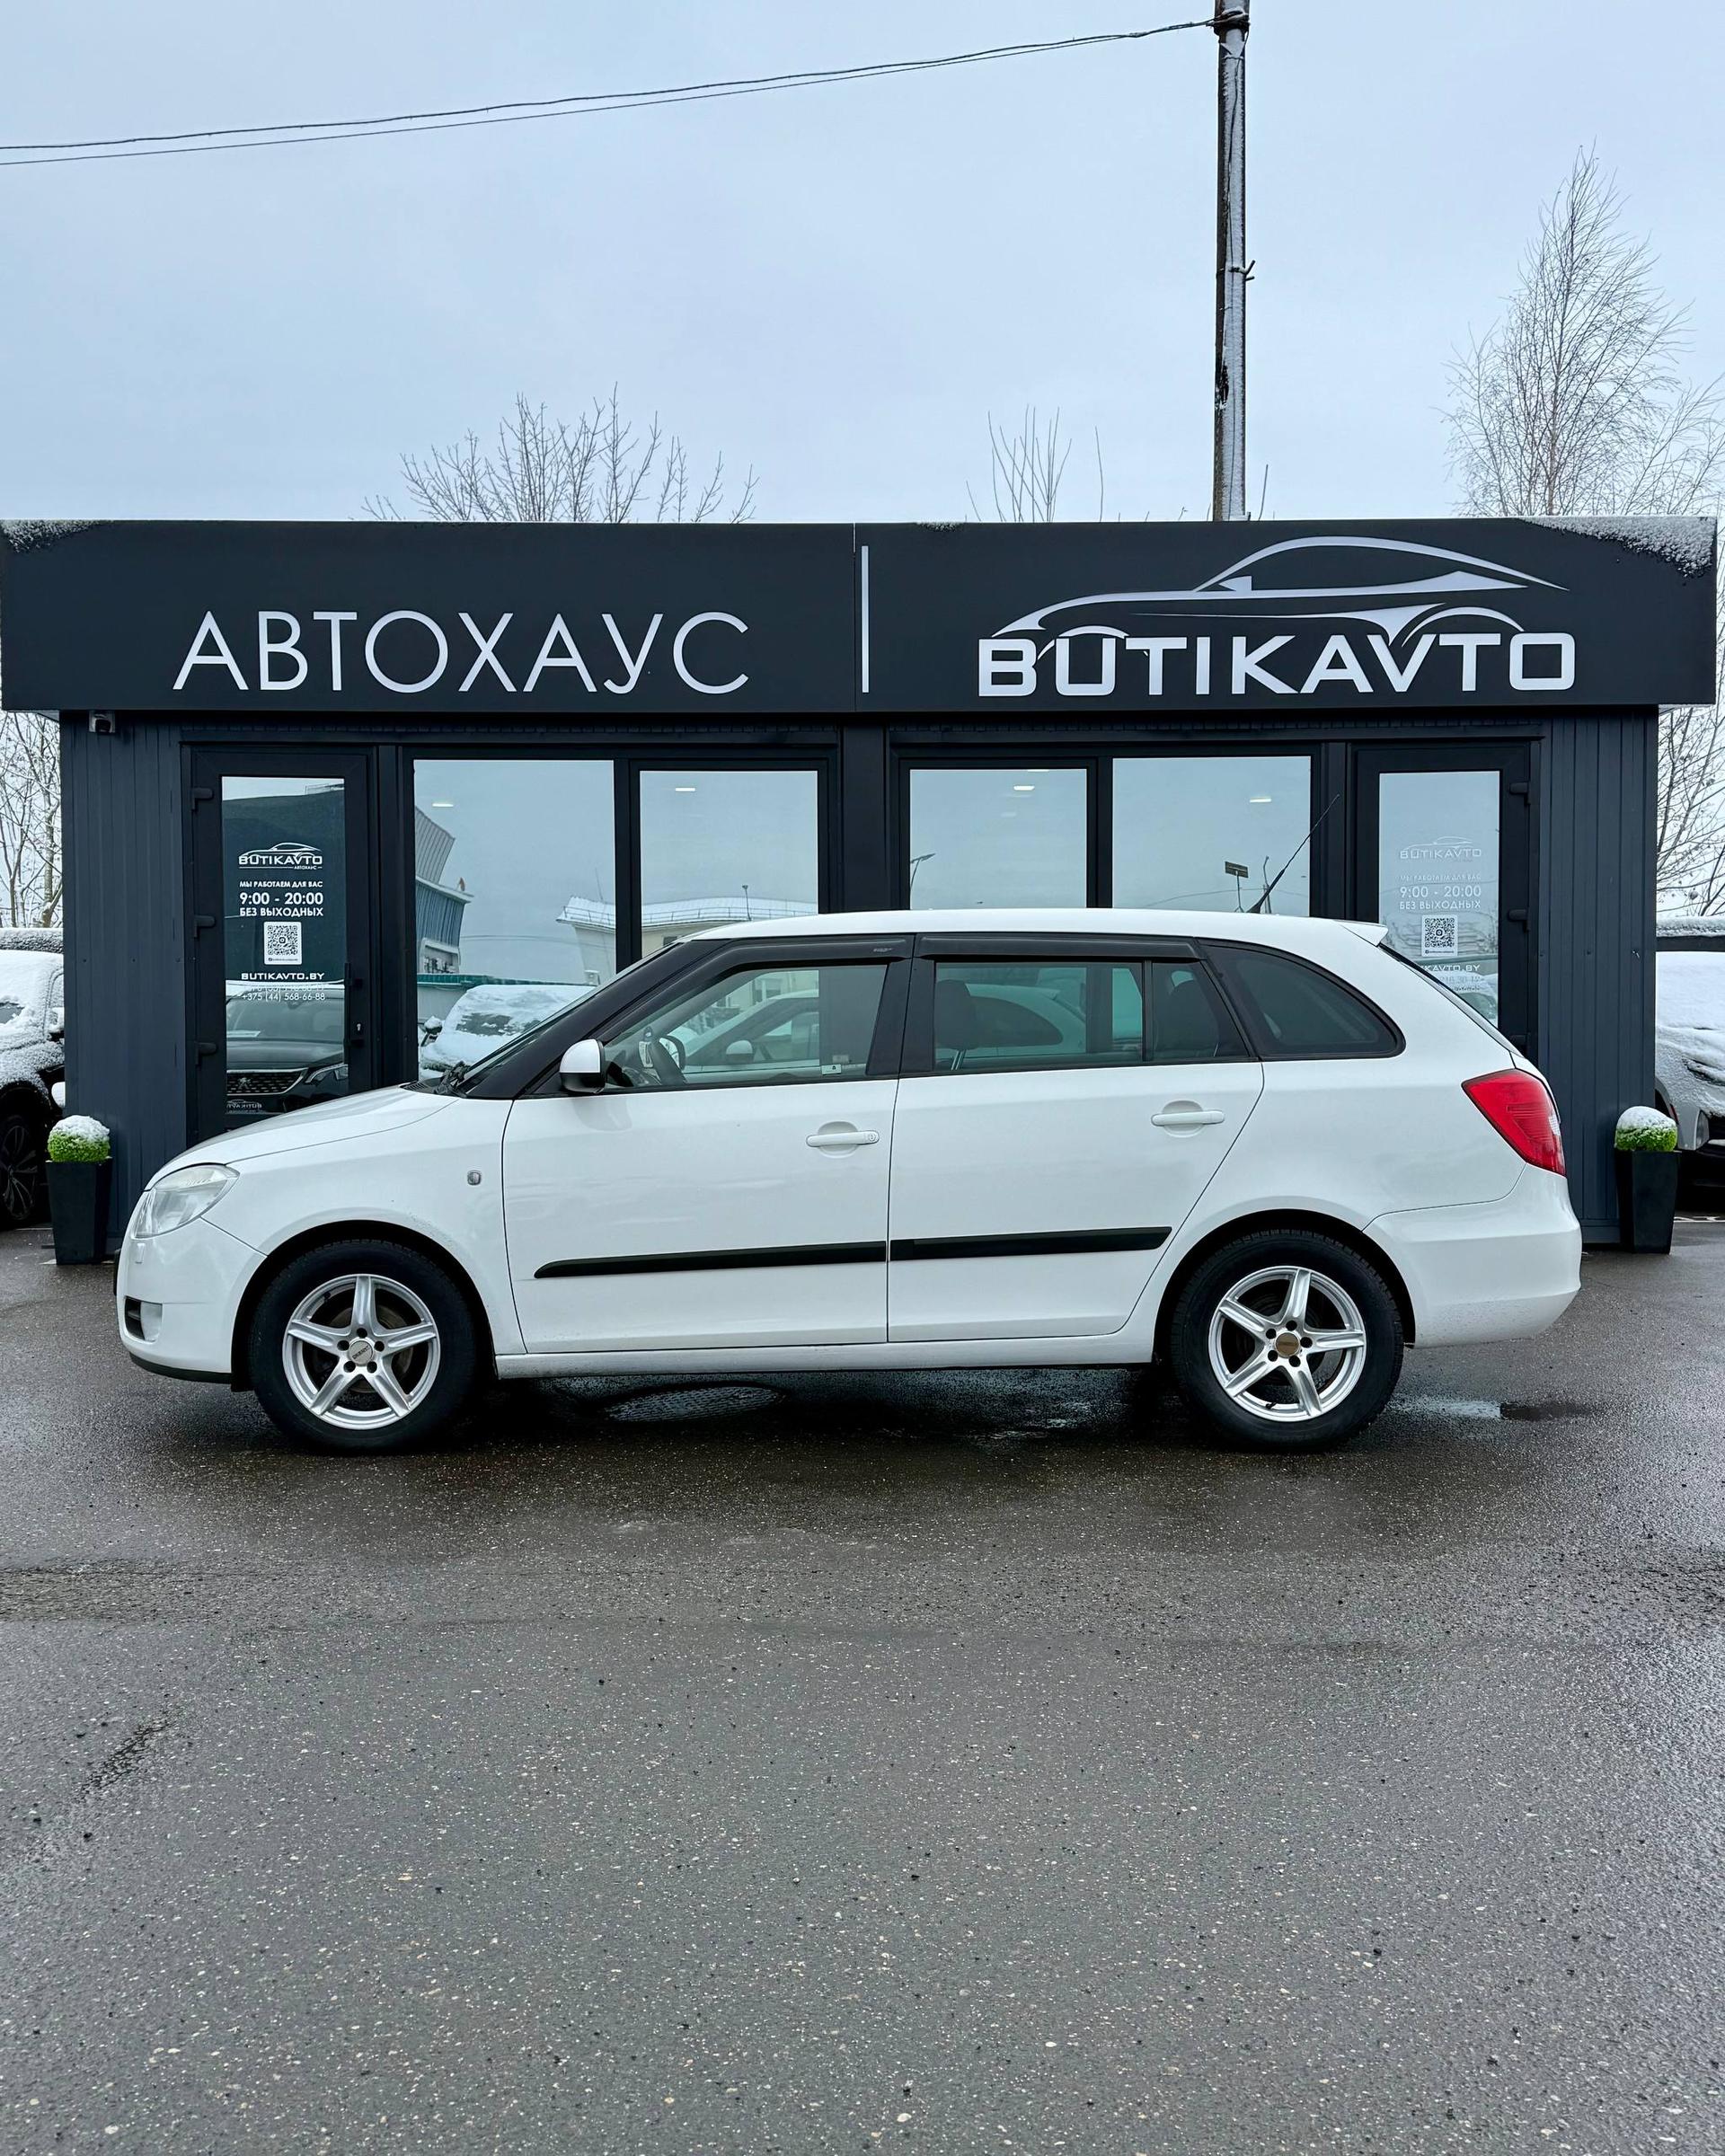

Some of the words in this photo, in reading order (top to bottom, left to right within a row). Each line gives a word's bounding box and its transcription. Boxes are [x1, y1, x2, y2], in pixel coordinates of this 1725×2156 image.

[172, 610, 749, 694] АВТОХАУС
[978, 632, 1576, 697] BUTIKAVTO
[1400, 848, 1482, 859] BUTIKAVTO
[238, 855, 323, 865] BUTIKAVTO
[1400, 886, 1429, 897] 9:00
[1444, 885, 1482, 897] 20:00
[239, 892, 270, 905] 9:00
[284, 892, 323, 905] 20:00
[1400, 901, 1416, 910] БЕЗ
[1420, 900, 1481, 910] ВЫХОДНЫХ
[239, 907, 257, 916] БЕЗ
[260, 907, 323, 917] ВЫХОДНЫХ
[242, 993, 263, 1001] +375
[265, 993, 281, 1003] (44)
[284, 993, 325, 1001] 568-66-88
